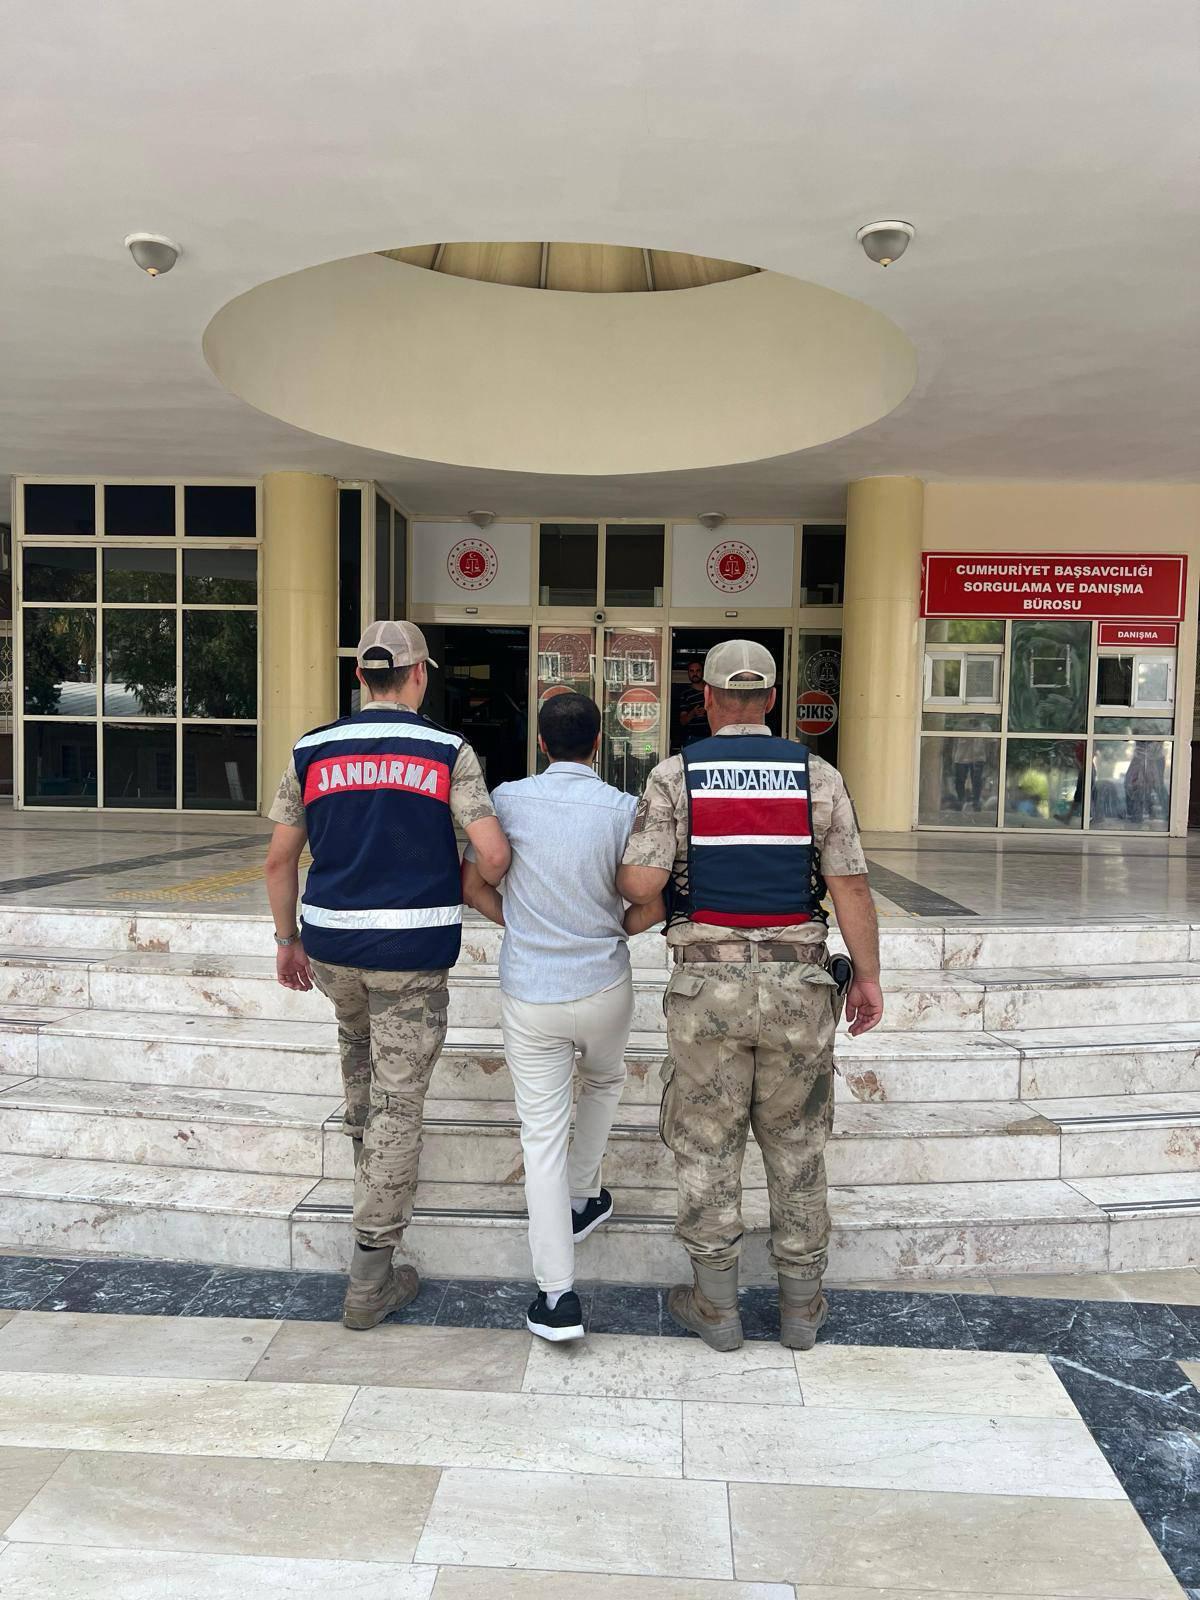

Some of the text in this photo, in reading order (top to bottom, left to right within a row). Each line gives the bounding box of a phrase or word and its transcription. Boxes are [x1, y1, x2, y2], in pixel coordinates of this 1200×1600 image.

[956, 563, 1153, 578] CUMHURİYET BAŞSAVCILIĞI
[963, 582, 1144, 596] SORGULAMA VE DANIŞMA
[1023, 598, 1082, 610] BÜROSU
[1117, 631, 1158, 640] DANIŞMA
[318, 760, 438, 794] JANDARMA
[700, 769, 799, 790] JANDARMA
